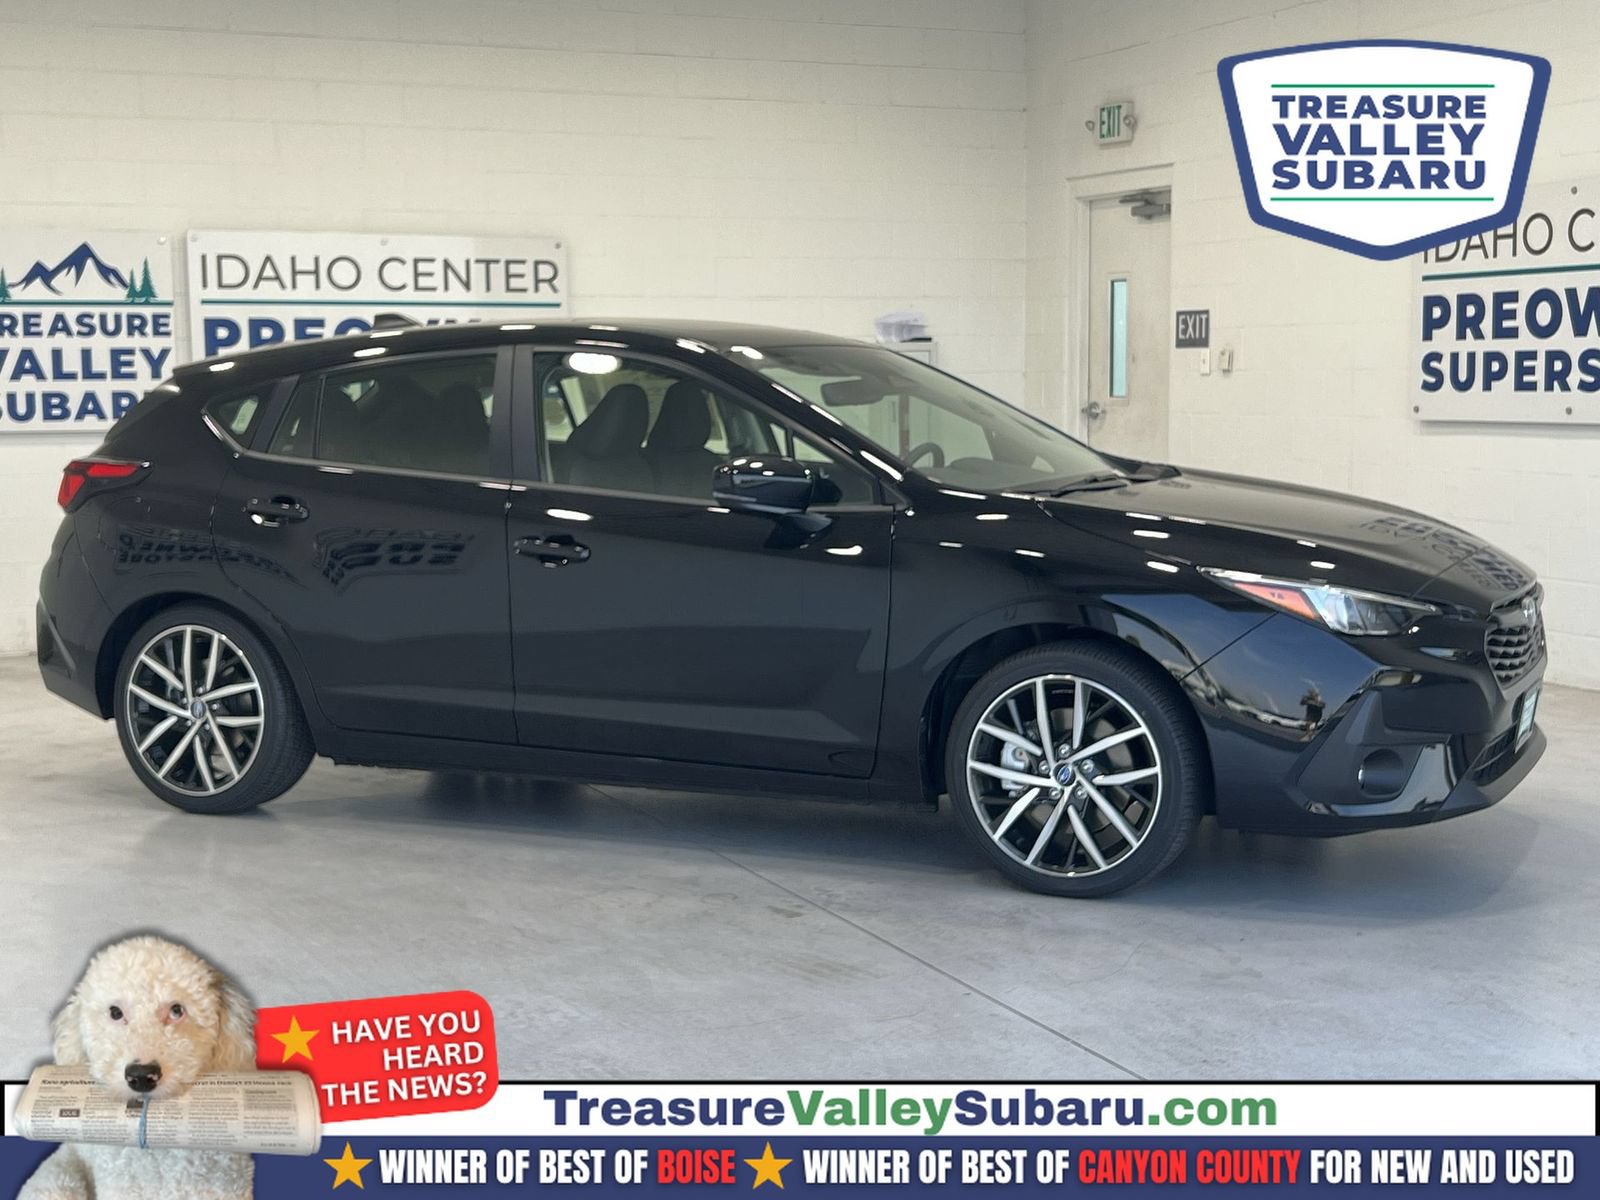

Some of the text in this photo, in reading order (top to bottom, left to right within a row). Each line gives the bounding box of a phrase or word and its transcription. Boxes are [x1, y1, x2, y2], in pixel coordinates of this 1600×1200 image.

[1099, 104, 1122, 139] EXIT
[200, 253, 560, 294] IDAHO CENTER
[1178, 314, 1208, 339] EXIT
[0, 347, 172, 380] ALLEY
[0, 391, 140, 422] UBAR
